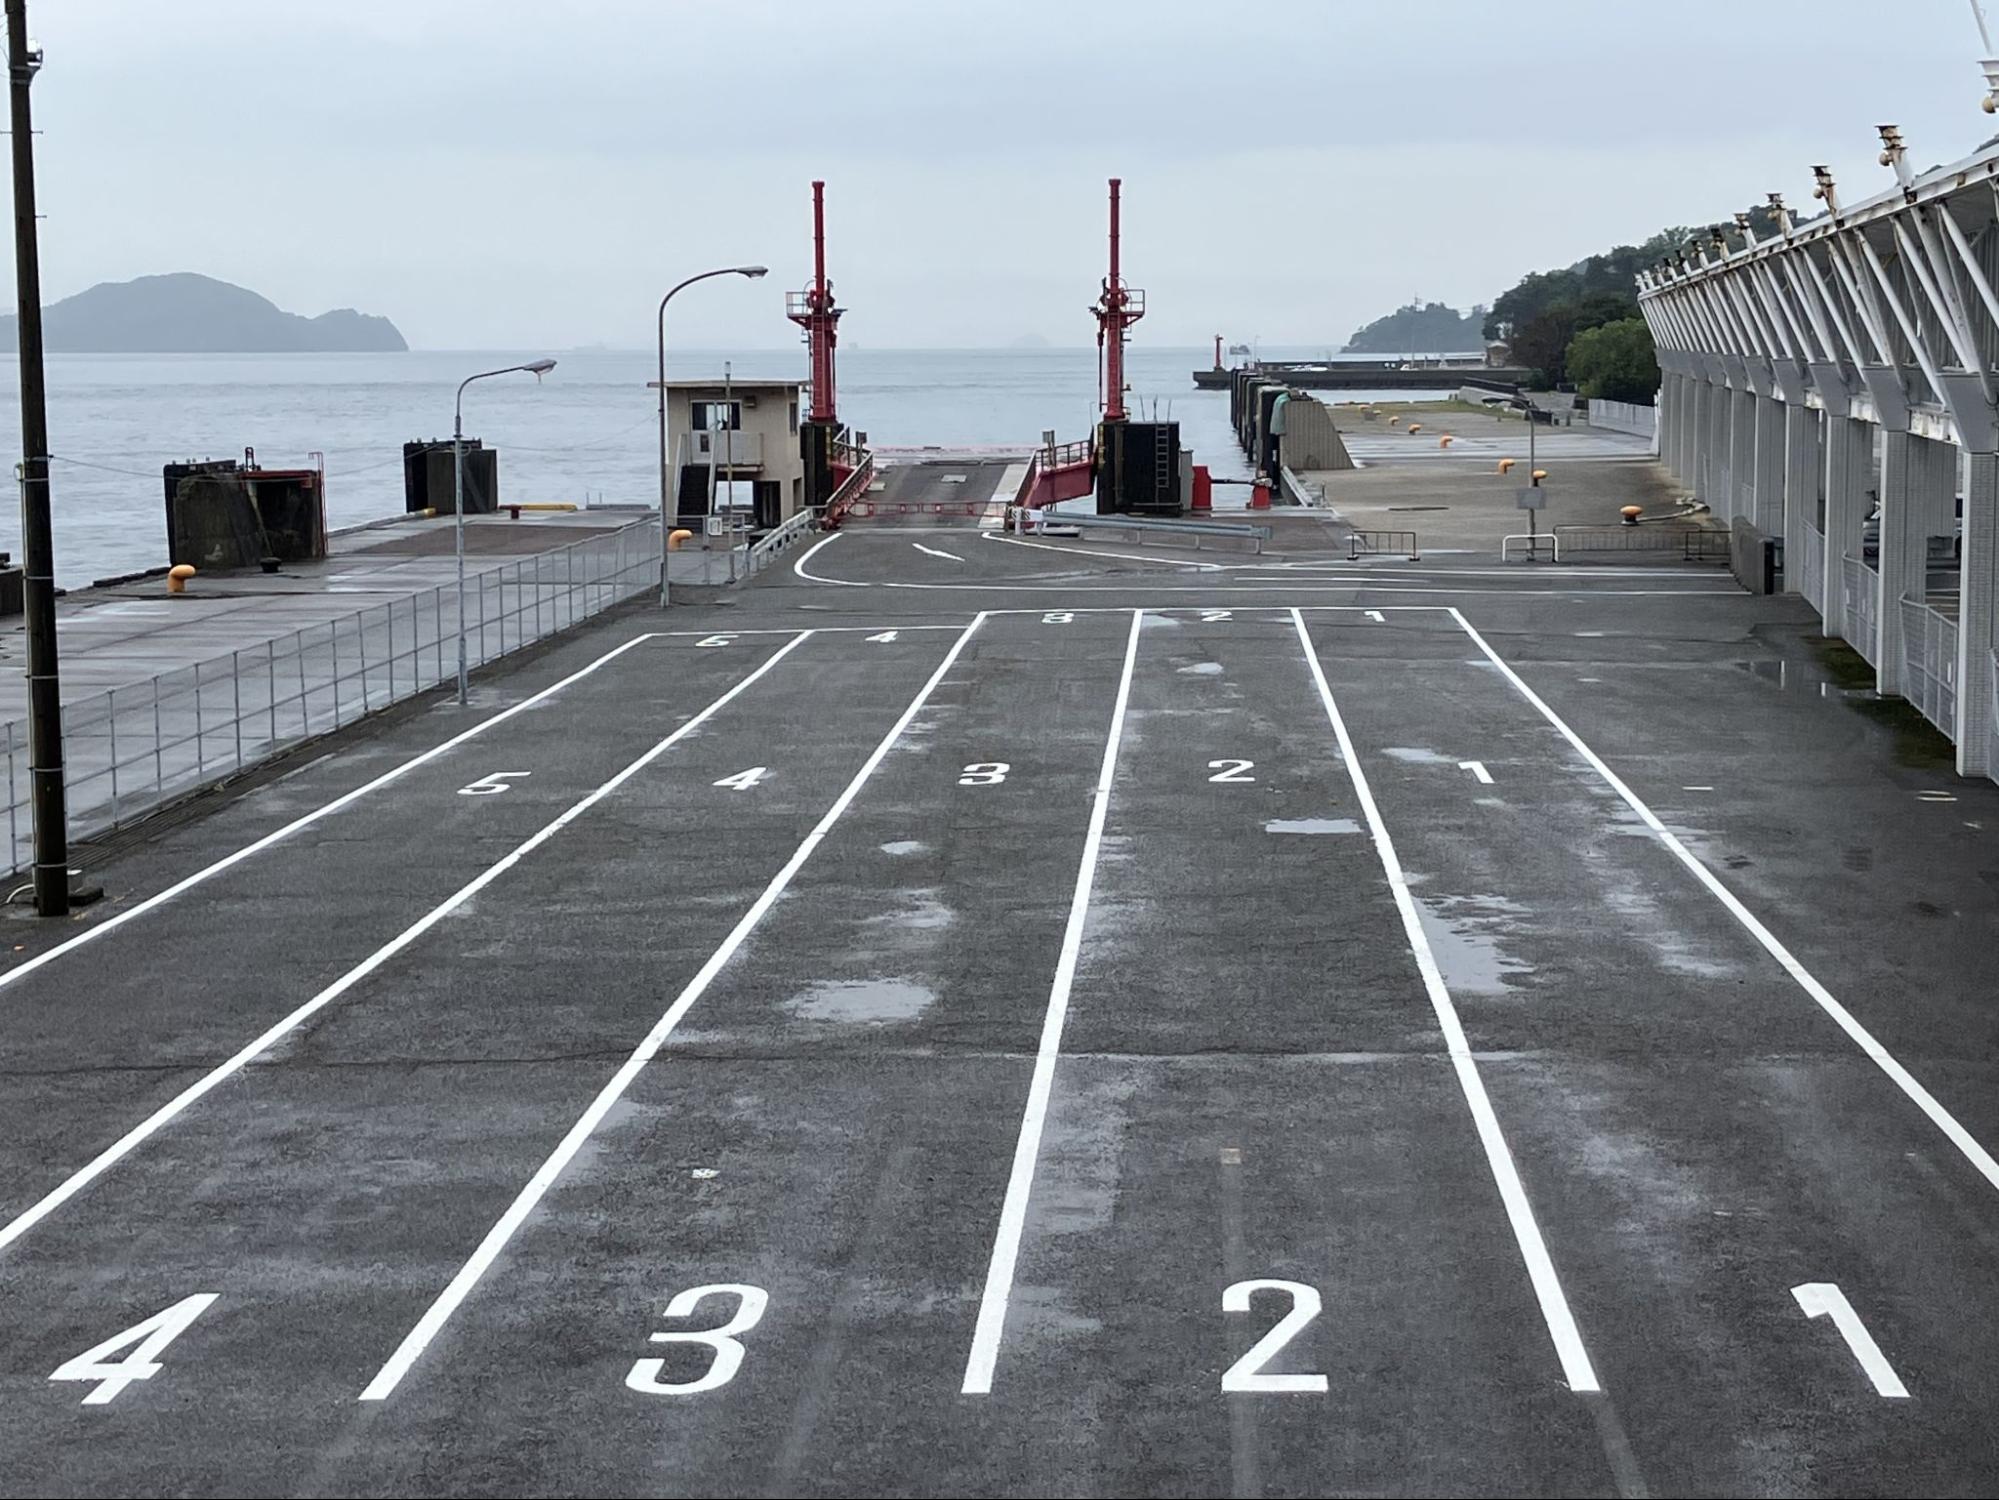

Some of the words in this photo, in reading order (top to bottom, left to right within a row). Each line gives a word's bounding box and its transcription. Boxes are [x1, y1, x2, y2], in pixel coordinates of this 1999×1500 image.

[1200, 610, 1233, 622] 2
[1364, 610, 1385, 622] 1
[865, 631, 898, 643] 4
[712, 767, 767, 791] 4
[958, 762, 1010, 785] 3
[1208, 759, 1255, 782] 2
[1457, 760, 1495, 784] 1
[457, 771, 532, 795] 5
[625, 1283, 769, 1396] 3
[1221, 1279, 1329, 1393] 2
[1790, 1282, 1911, 1398] 1
[47, 1293, 220, 1405] 4
